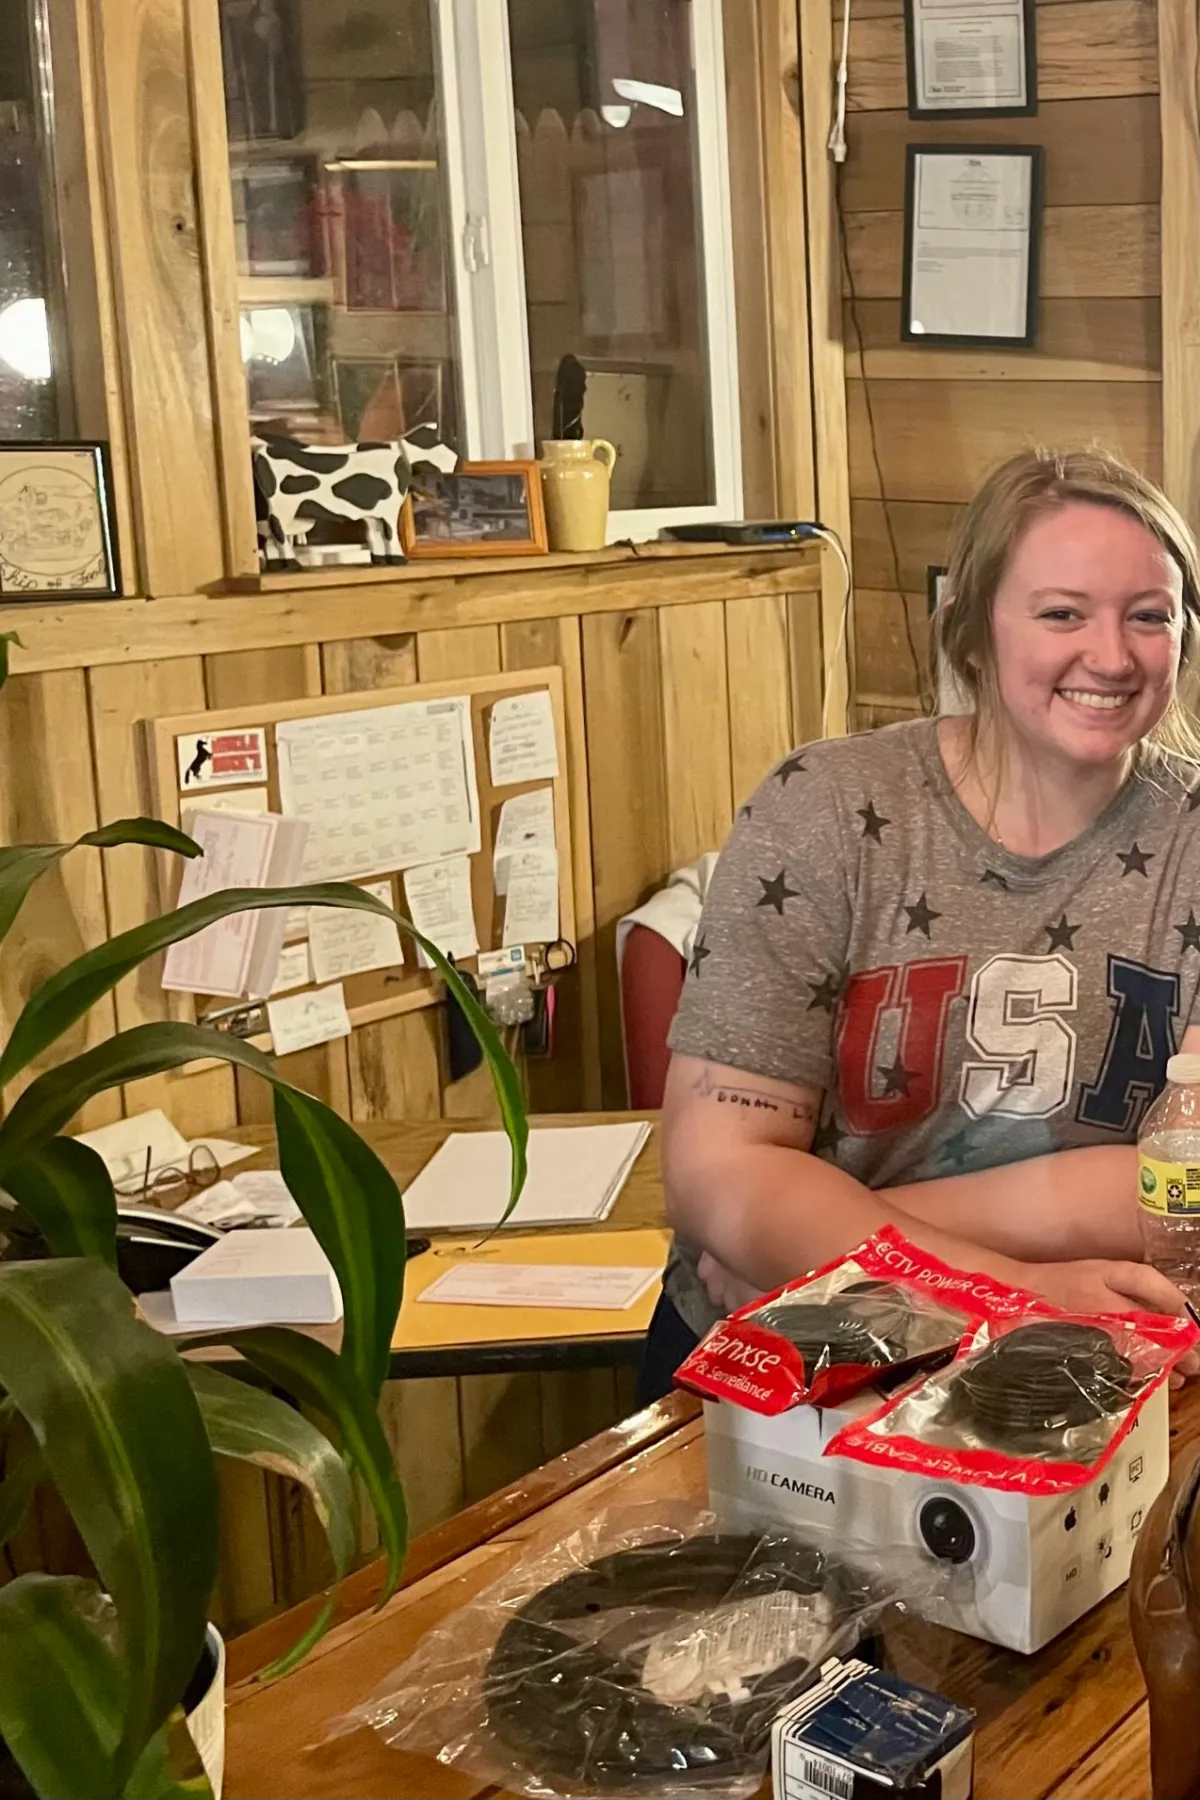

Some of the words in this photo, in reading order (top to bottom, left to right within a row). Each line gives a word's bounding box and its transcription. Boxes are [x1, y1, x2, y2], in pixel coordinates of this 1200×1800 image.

[835, 952, 1181, 1137] USA
[915, 1268, 974, 1292] POWER
[745, 1465, 768, 1484] HD
[770, 1473, 836, 1505] CAMERA
